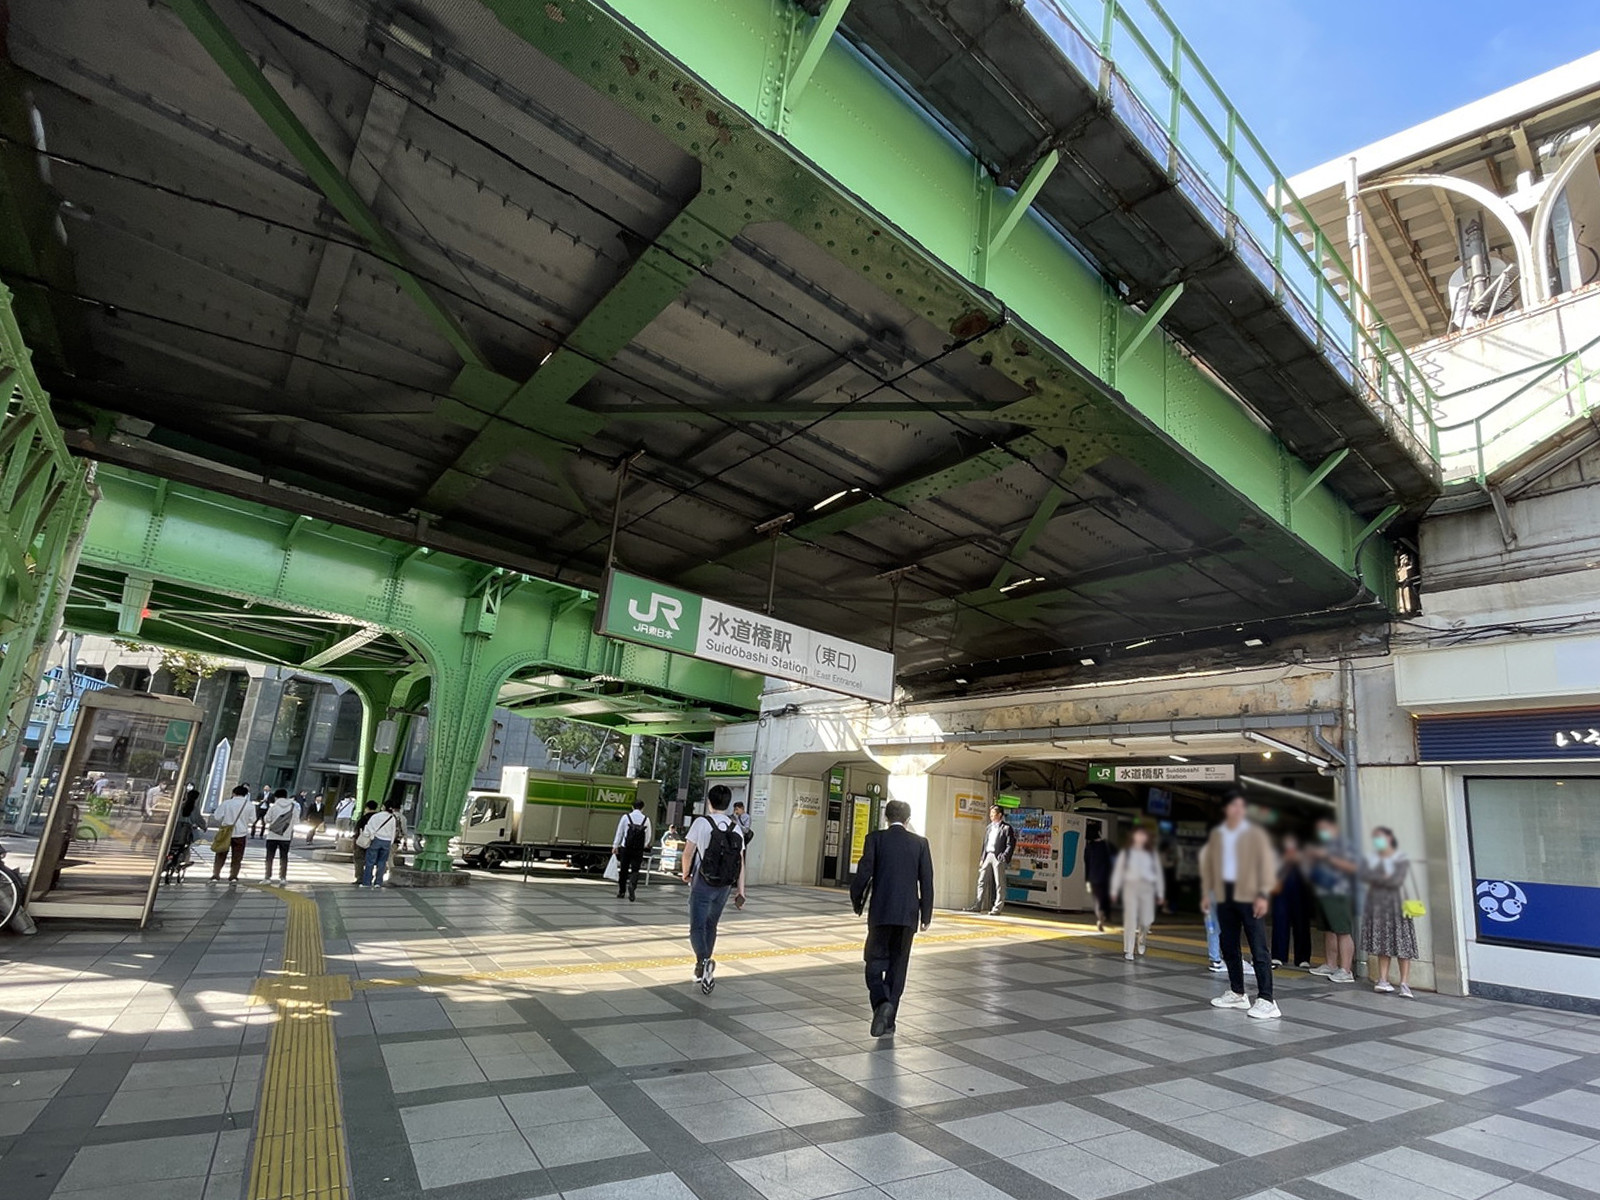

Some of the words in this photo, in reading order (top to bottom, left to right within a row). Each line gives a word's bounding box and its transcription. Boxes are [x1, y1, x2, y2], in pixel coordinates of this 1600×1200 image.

[628, 592, 683, 631] JR
[632, 622, 674, 639] JR東日本
[708, 612, 793, 655] 水道橋駅
[771, 656, 808, 676] Station
[813, 668, 832, 682] (East
[832, 674, 863, 691] Entrance)
[708, 758, 749, 773] NewDays
[1097, 768, 1111, 778] JR
[1120, 768, 1164, 780] 水道橋駅
